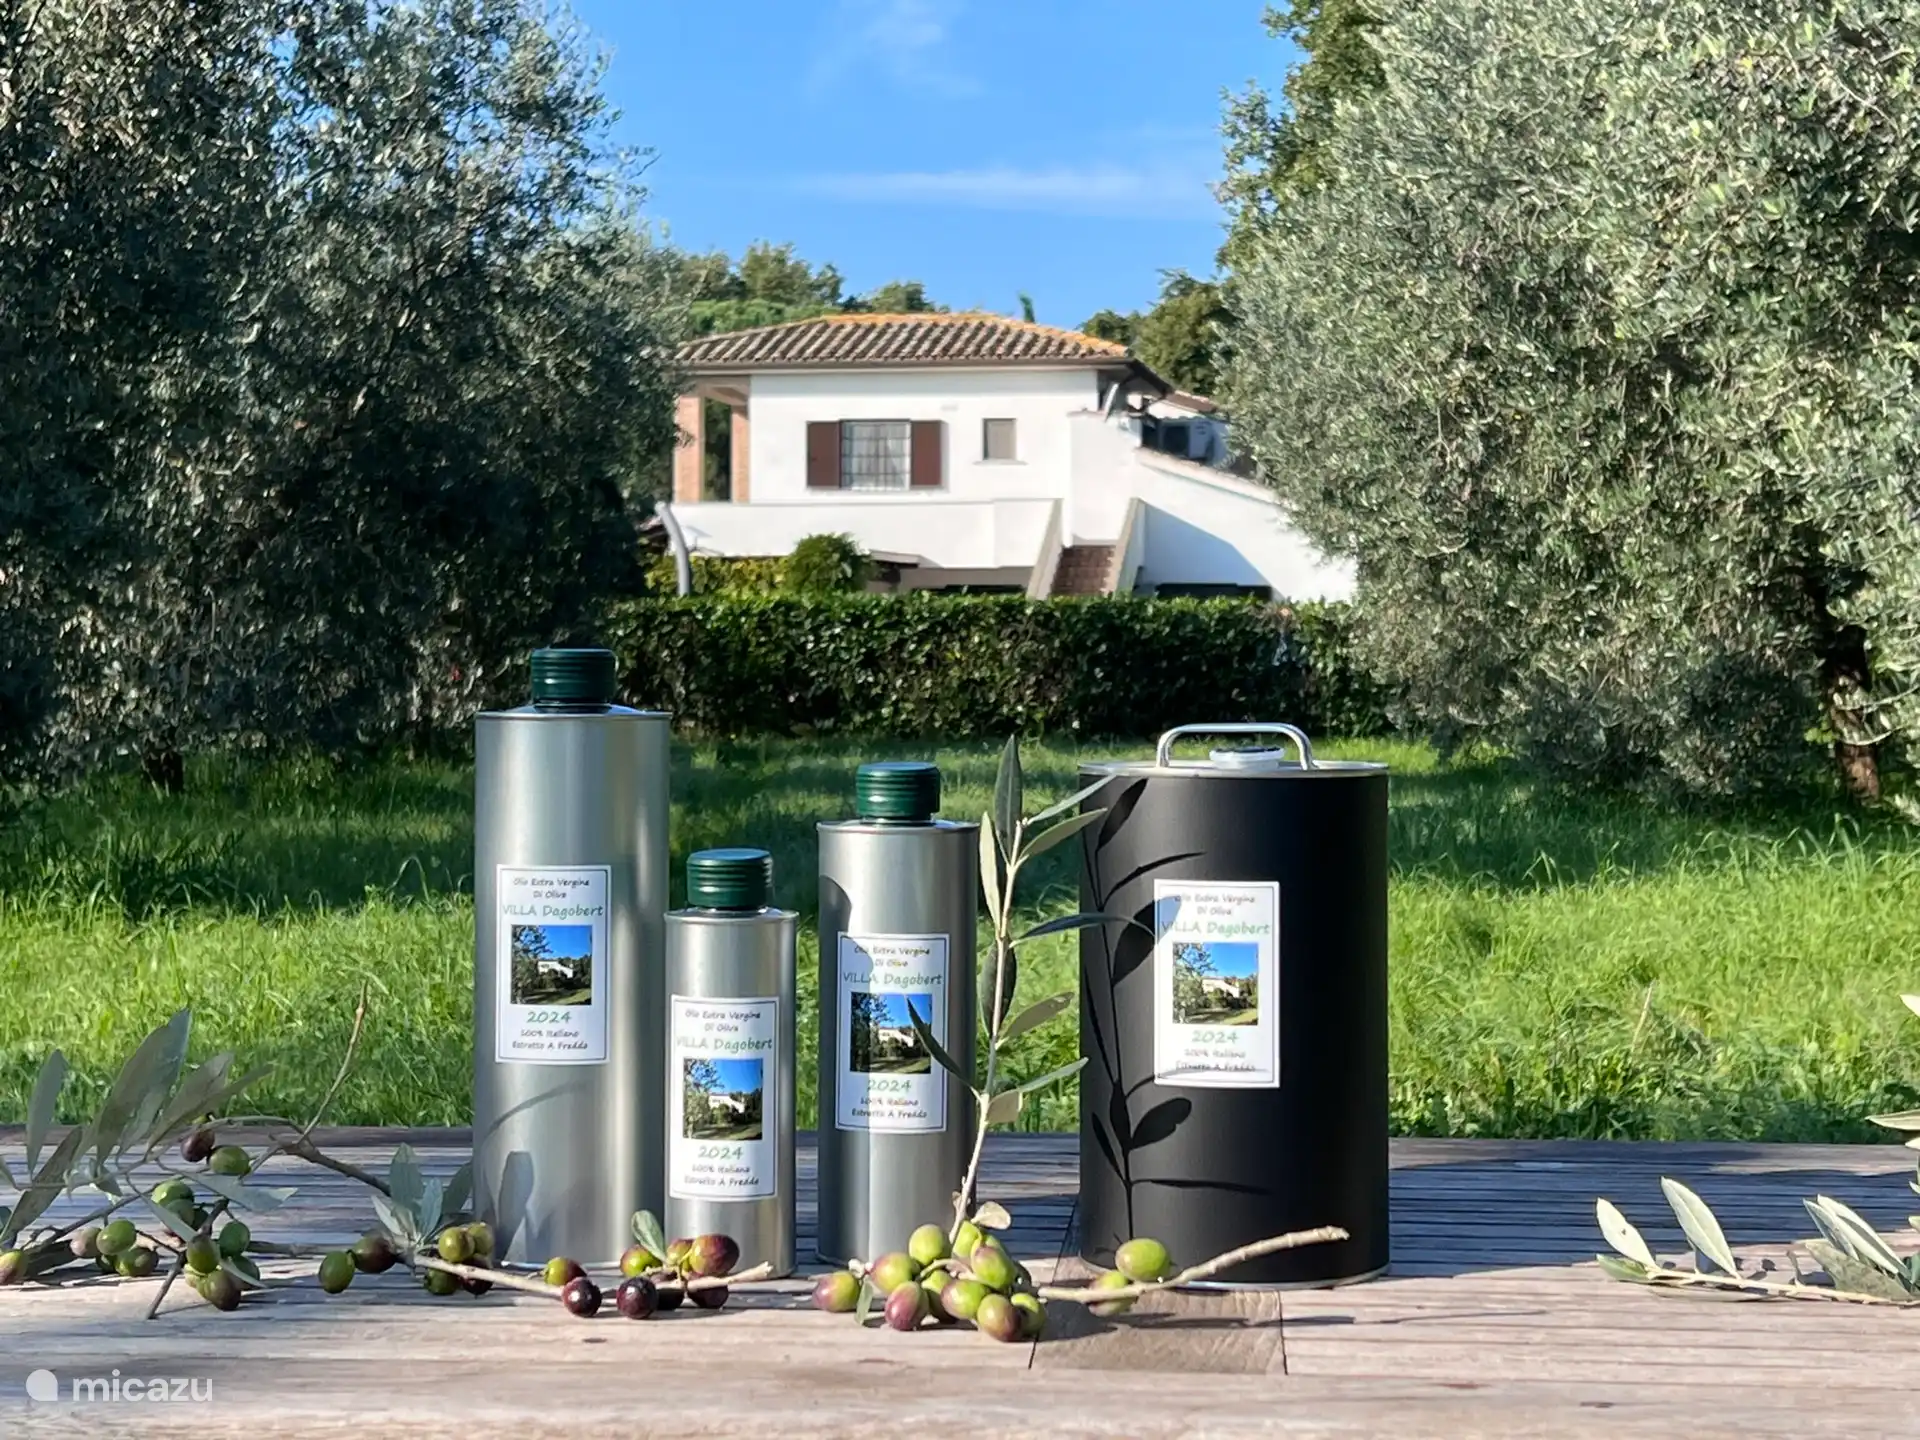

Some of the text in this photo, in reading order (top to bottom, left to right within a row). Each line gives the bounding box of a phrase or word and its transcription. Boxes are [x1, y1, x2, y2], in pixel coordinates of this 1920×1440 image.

[531, 878, 555, 887] Extra
[557, 878, 590, 889] Vergine
[503, 904, 604, 920] VILLA Dagobert
[1161, 921, 1270, 938] VILLA Dagobert
[844, 972, 943, 988] VILLA Dagobert
[526, 1011, 572, 1024] 2024
[729, 1011, 761, 1022] Vergine
[1191, 1030, 1238, 1044] 2024
[676, 1036, 773, 1053] VILLA Dagobert
[867, 1080, 912, 1093] 2024
[697, 1145, 744, 1159] 2024
[729, 1176, 760, 1186] Freddo
